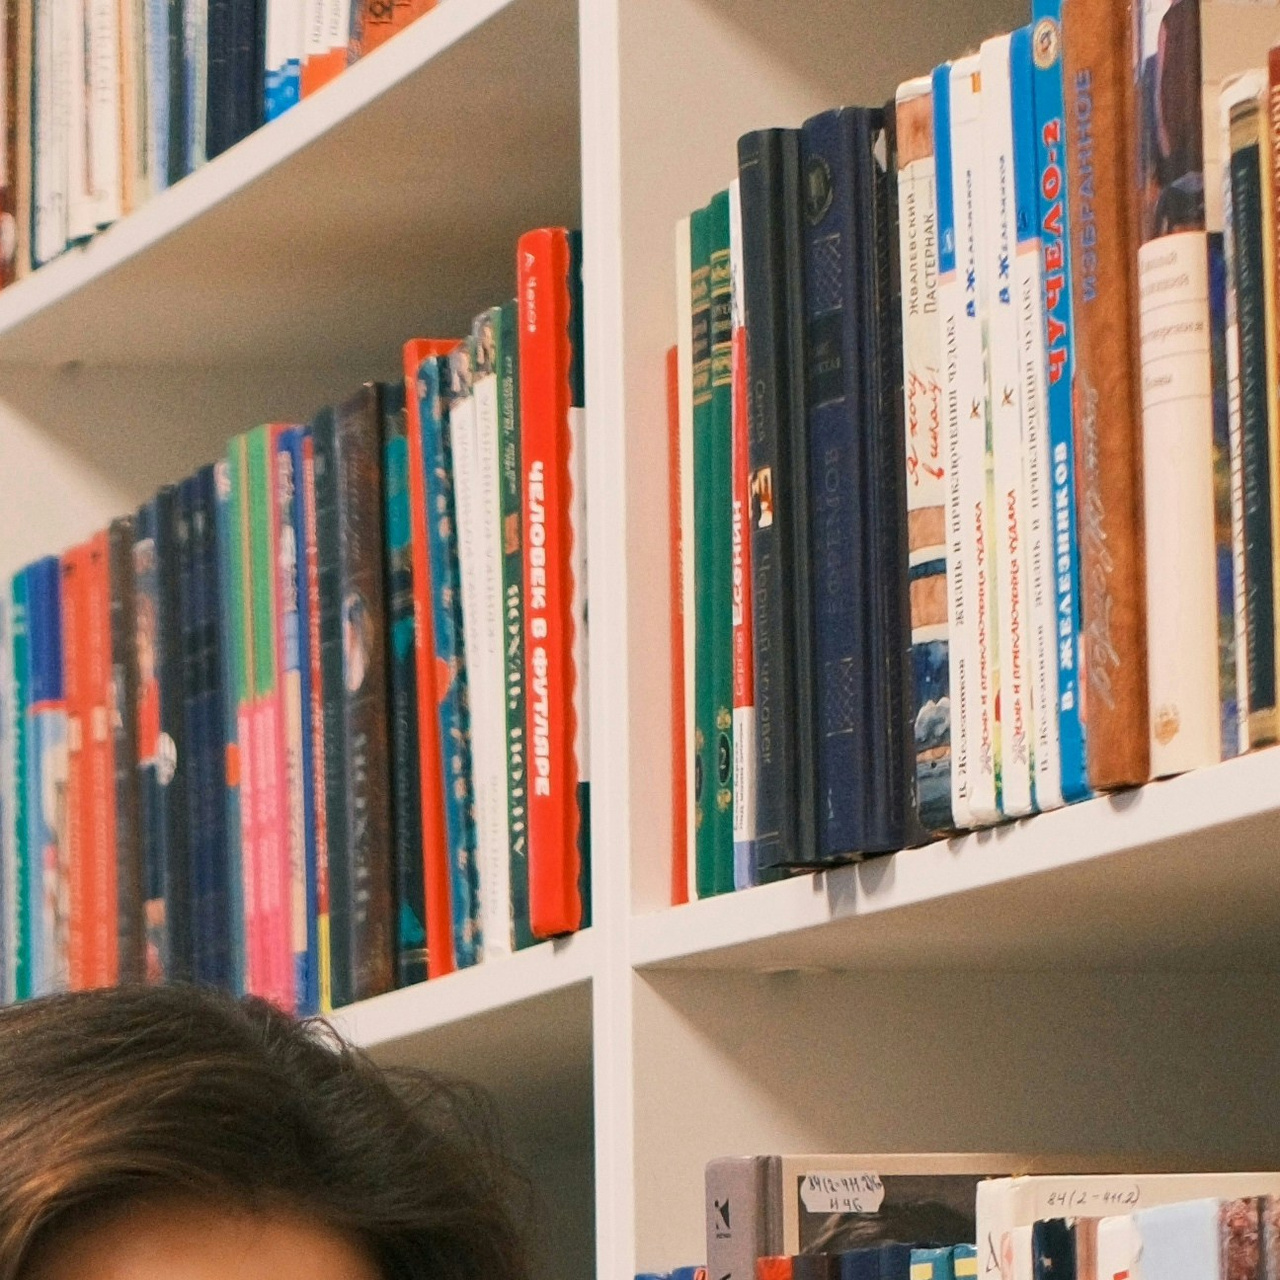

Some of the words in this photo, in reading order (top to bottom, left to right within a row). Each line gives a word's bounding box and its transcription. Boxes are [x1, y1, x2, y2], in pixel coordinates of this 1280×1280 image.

[1075, 67, 1097, 300] ИЗБРАННОЕ
[906, 193, 919, 315] ЖВАЛЕВСКИЙ
[924, 213, 938, 315] ПАСТЕРНАК
[1042, 118, 1066, 384] ЧУЧЕЛО-2
[907, 370, 927, 438] хочу
[925, 367, 942, 459] школу!
[948, 388, 962, 534] ПРИКЛЮЧЕНИЯ
[527, 460, 547, 610] ЧЕЛОВЕК
[1055, 441, 1073, 670] ЖЕЛЕЗНИКОВ
[531, 617, 549, 641] В
[1061, 679, 1074, 711] В.
[532, 646, 552, 797] ФУТЛЯРЕ
